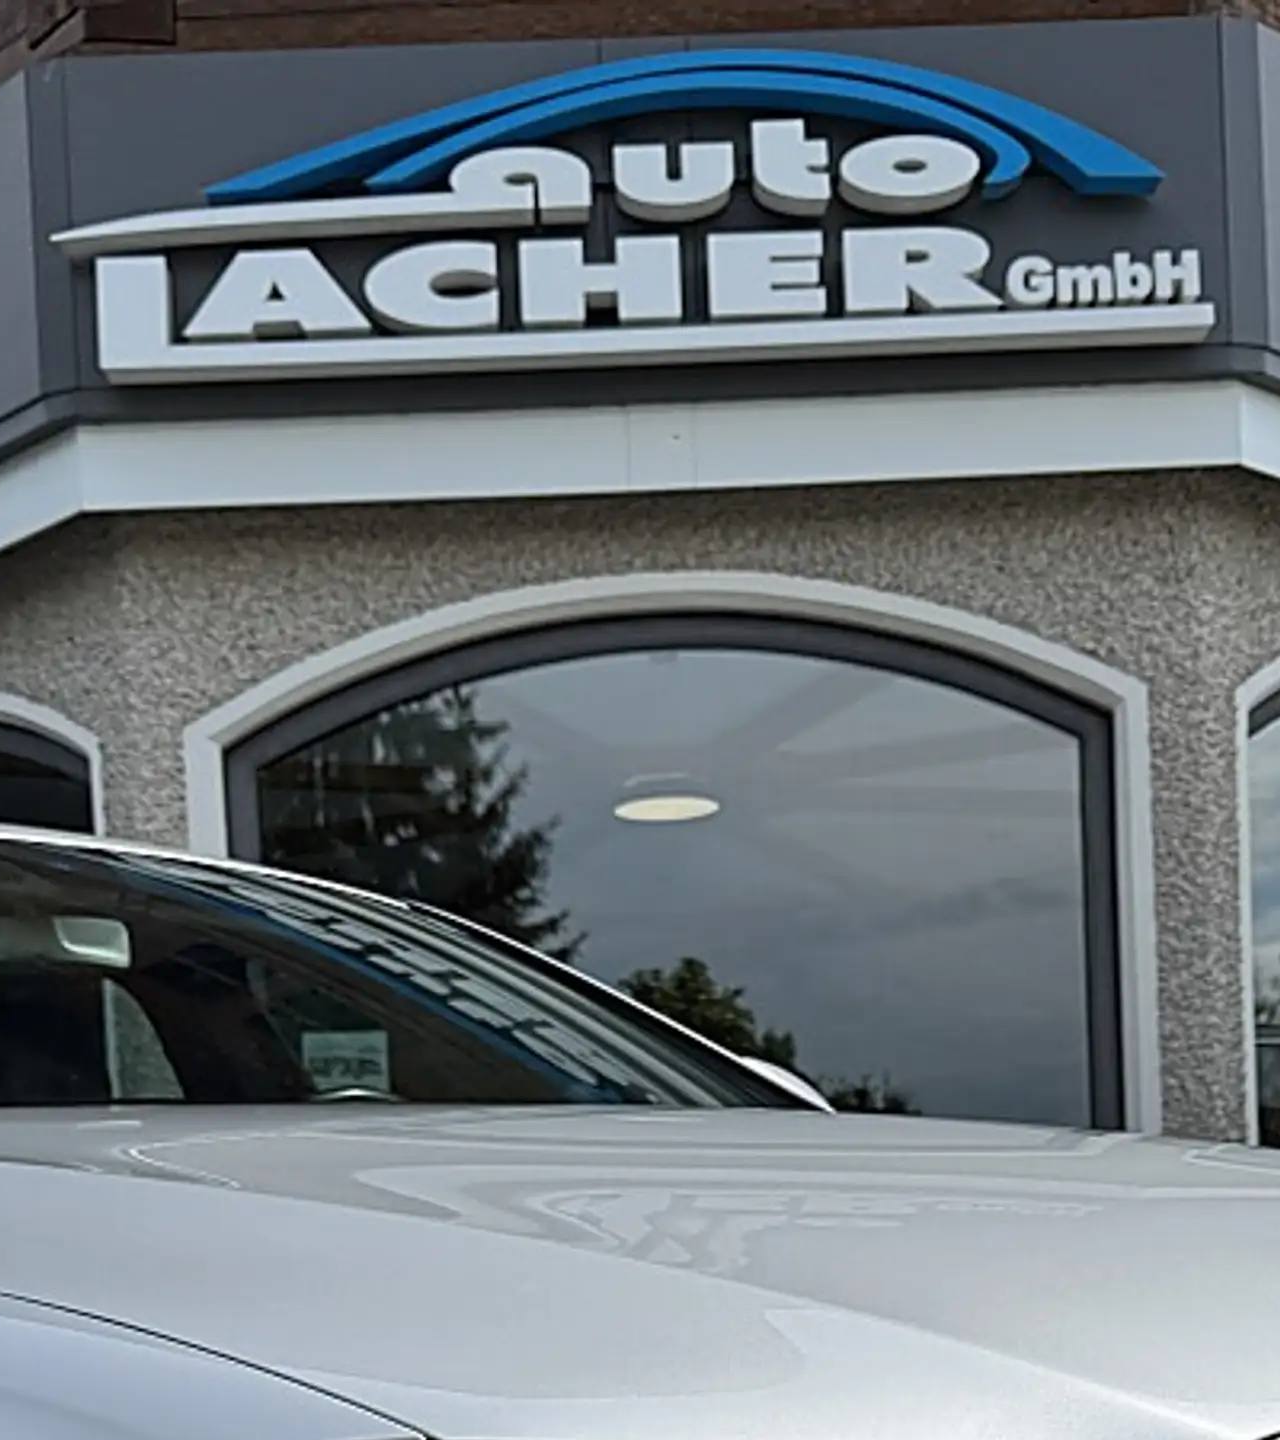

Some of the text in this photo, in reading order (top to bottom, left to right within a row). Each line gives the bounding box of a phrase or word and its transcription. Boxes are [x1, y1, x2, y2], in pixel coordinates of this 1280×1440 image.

[448, 118, 981, 222] auto
[96, 225, 1202, 372] LACHER GmbH
